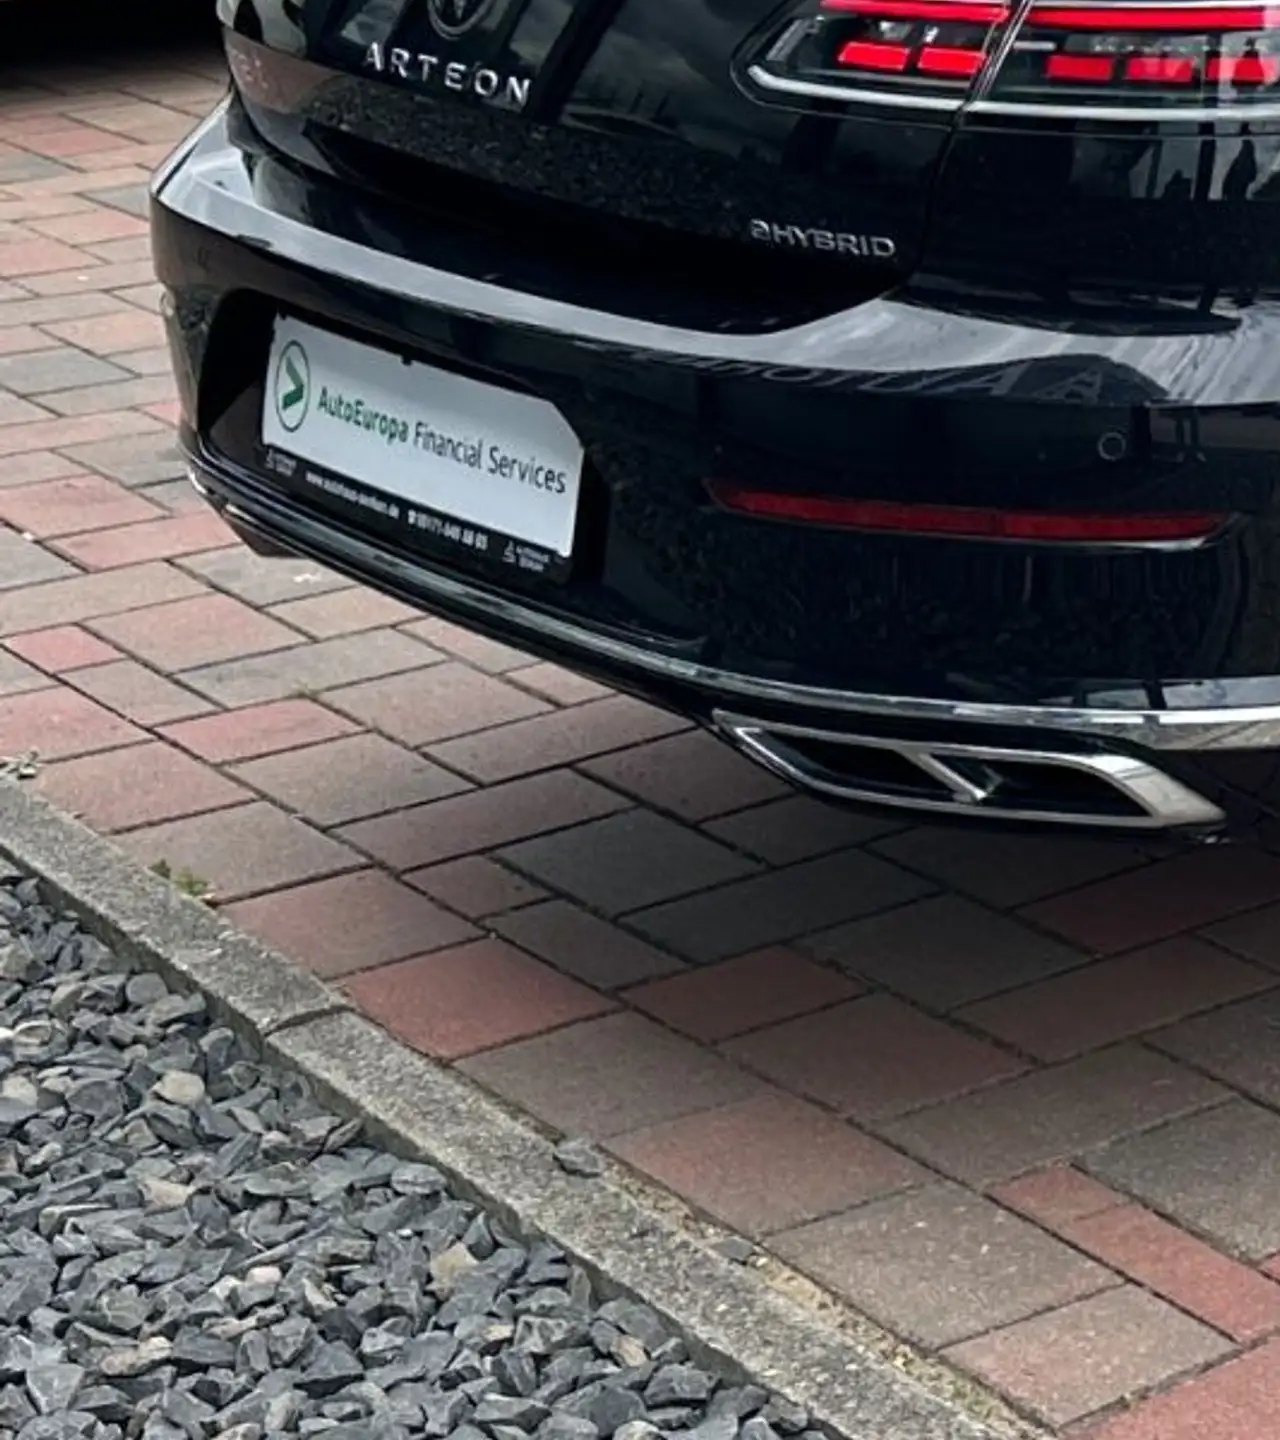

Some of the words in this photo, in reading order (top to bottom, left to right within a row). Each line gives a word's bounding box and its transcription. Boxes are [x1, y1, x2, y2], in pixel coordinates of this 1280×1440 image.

[363, 41, 531, 106] ARTEON
[317, 386, 409, 445] AutoEuropa
[413, 420, 483, 470] Financial
[488, 446, 567, 494] Services
